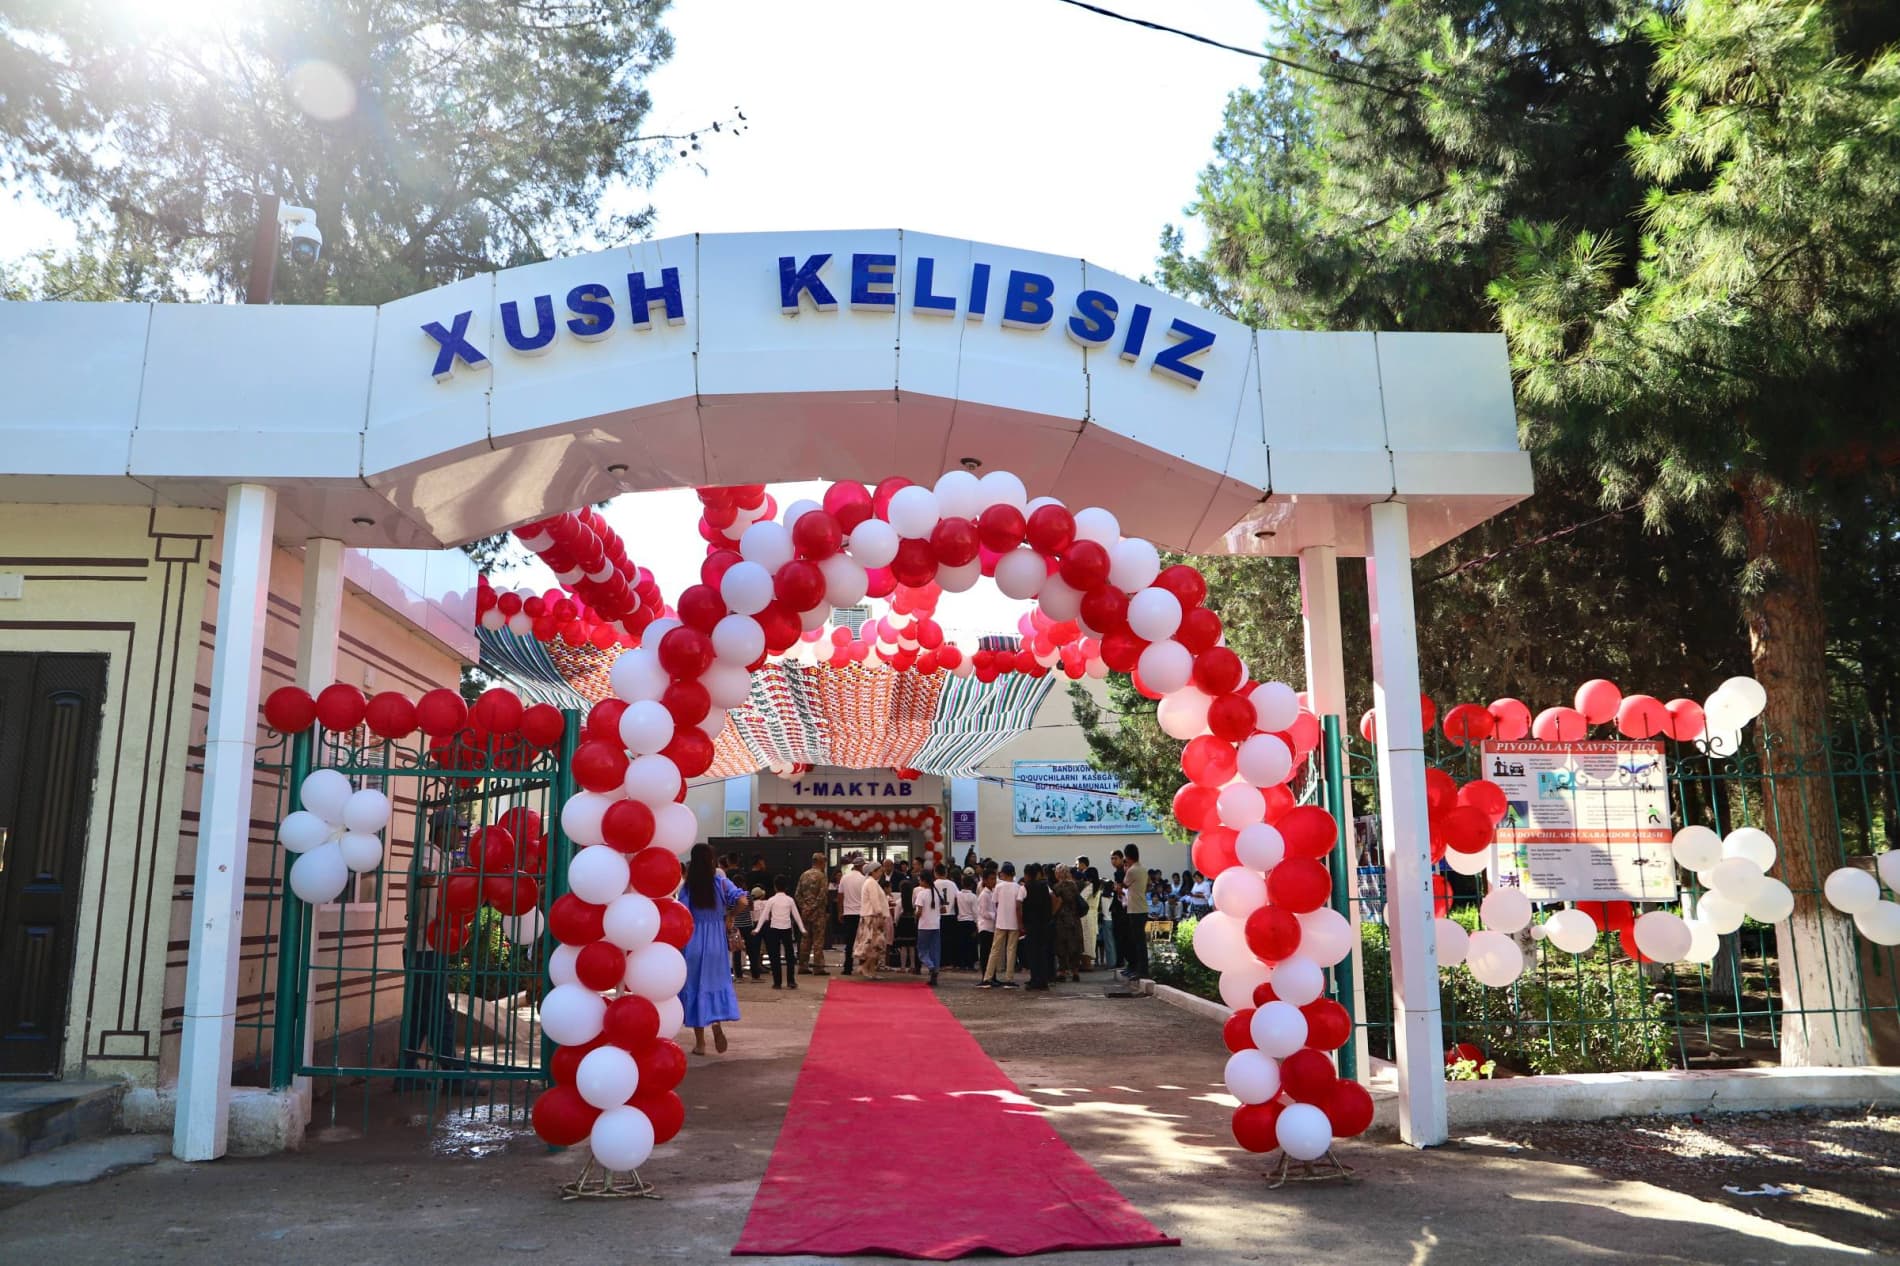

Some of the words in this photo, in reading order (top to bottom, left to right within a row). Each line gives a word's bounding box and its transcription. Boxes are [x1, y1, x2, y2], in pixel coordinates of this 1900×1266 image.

[420, 267, 685, 380] XUSH
[779, 253, 1216, 387] KELIBSIZ
[1496, 742, 1572, 752] PIYODALAR
[1052, 764, 1091, 773] BANDIXON
[1082, 774, 1112, 782] KASBGA
[793, 781, 912, 796] 1-MAKTAB
